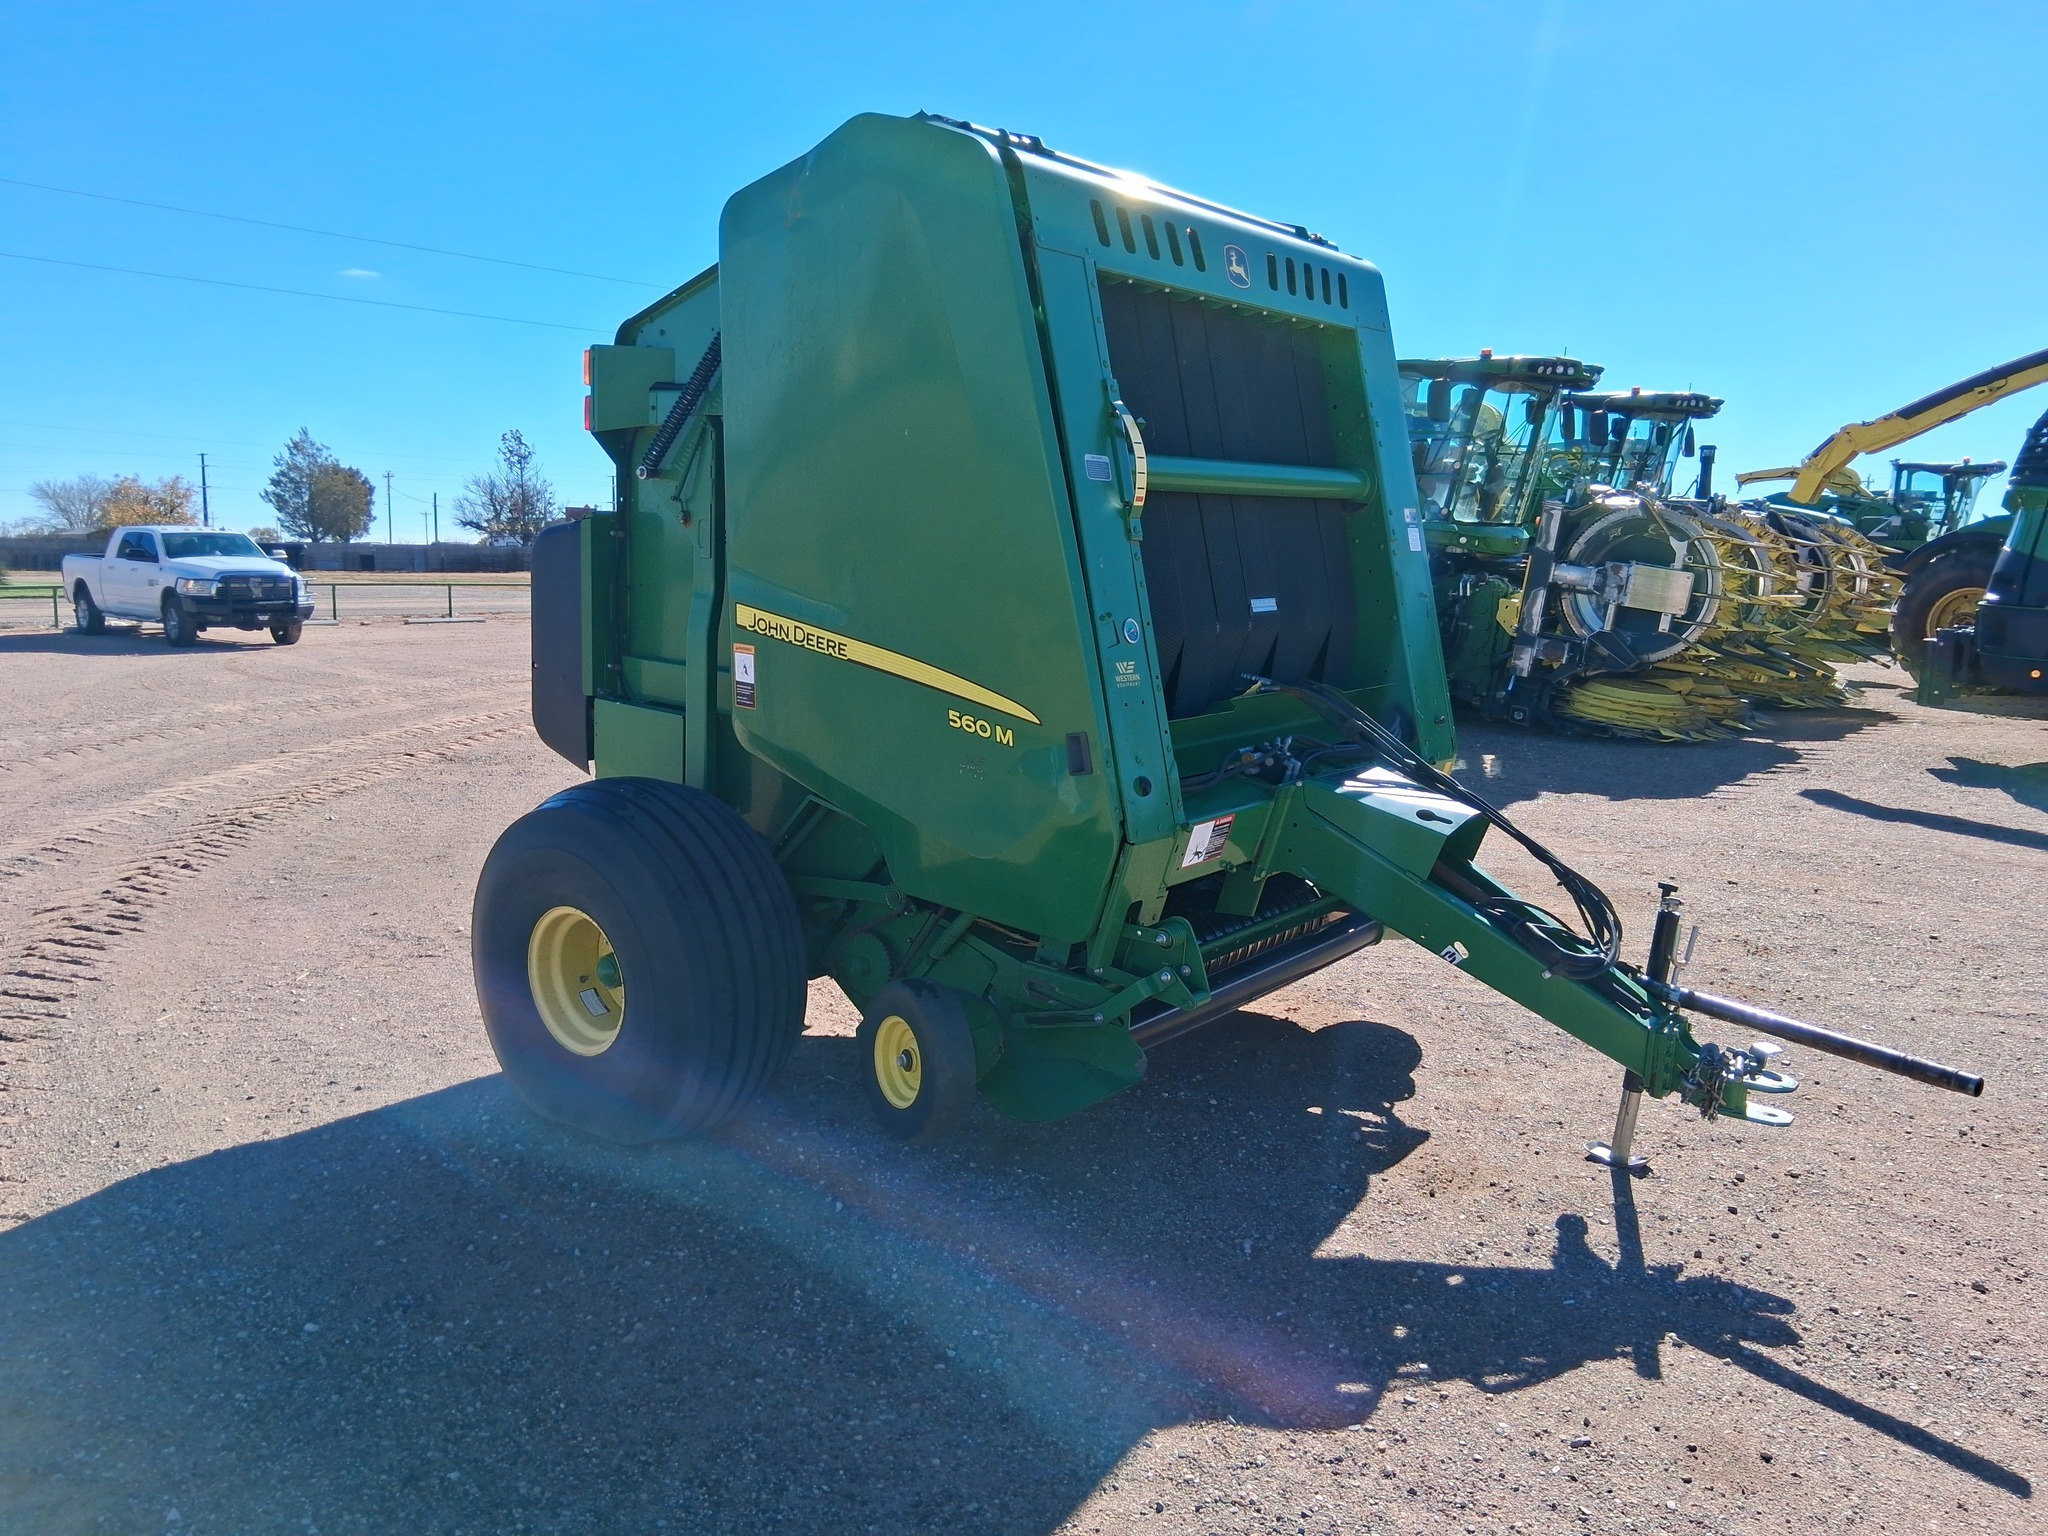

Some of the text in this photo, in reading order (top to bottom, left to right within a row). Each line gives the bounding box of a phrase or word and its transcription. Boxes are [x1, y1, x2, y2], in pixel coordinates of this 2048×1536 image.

[748, 612, 848, 658] JOHN DEERE
[1115, 673, 1141, 683] WESTERN
[948, 708, 1014, 748] 560 M
